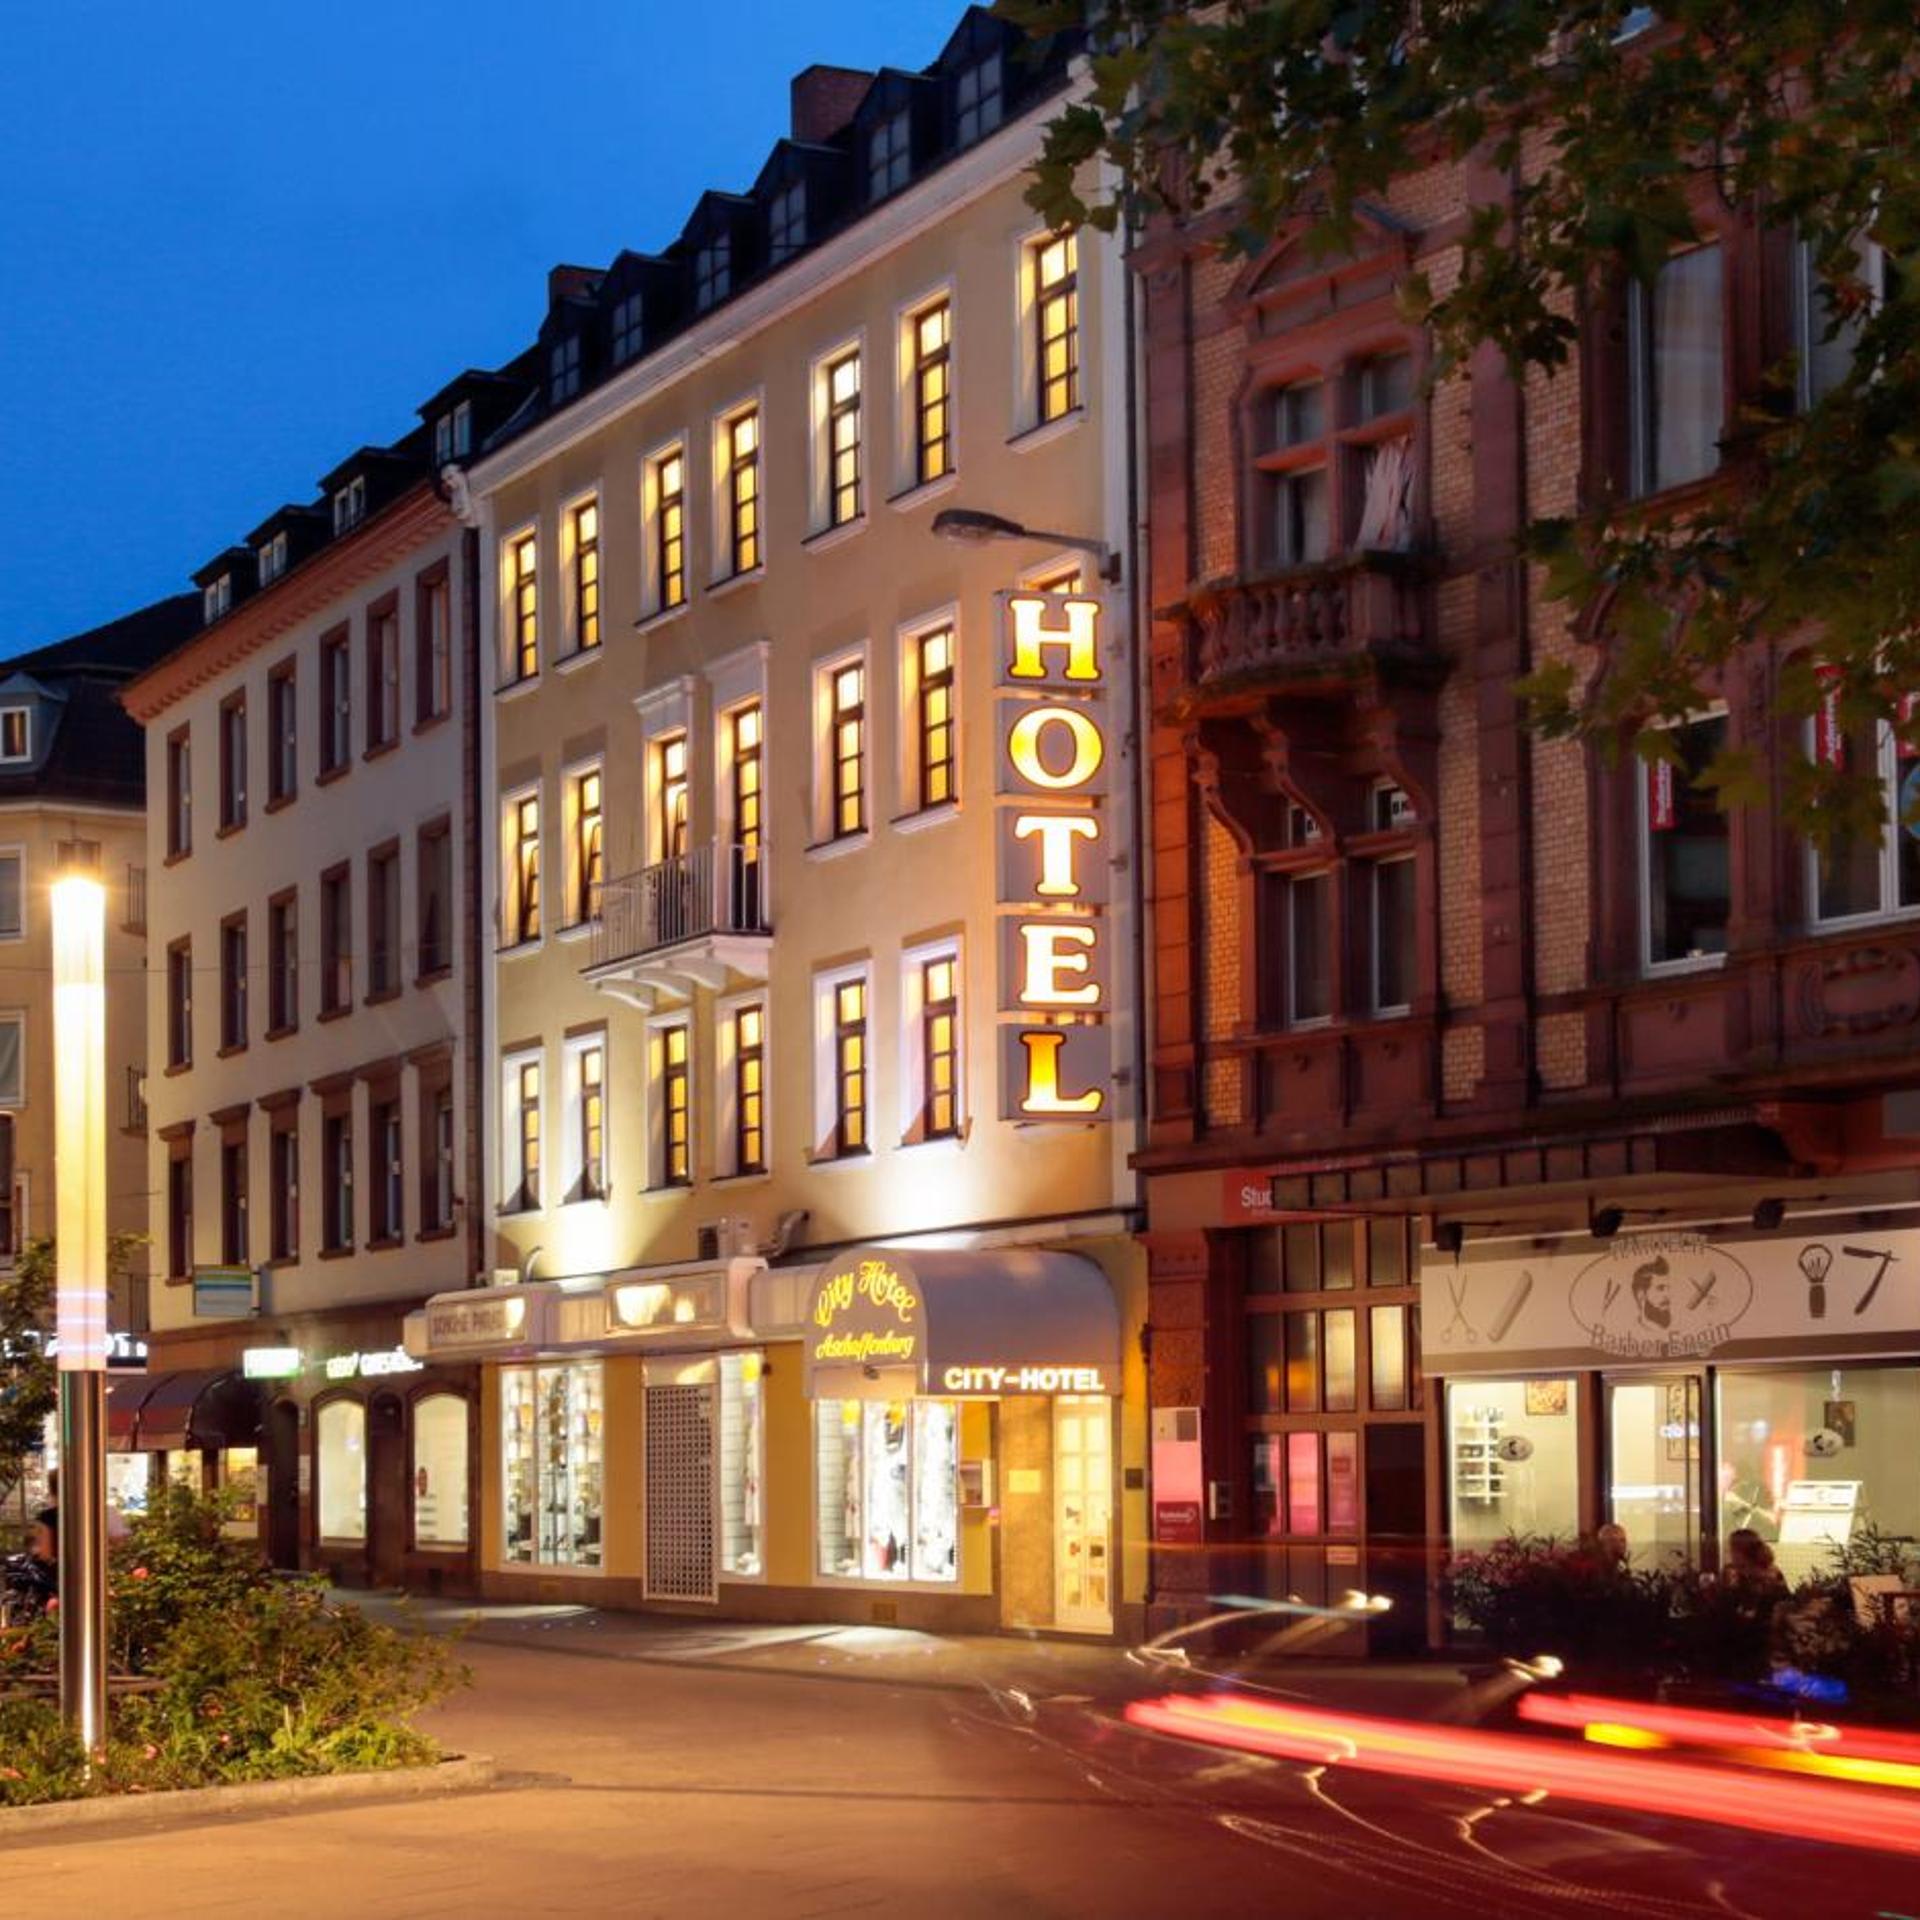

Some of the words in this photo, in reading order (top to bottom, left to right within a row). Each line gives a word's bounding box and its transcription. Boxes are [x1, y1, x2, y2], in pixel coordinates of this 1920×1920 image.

[1007, 597, 1104, 1114] HOTEL
[816, 1272, 855, 1327] City
[857, 1261, 916, 1323] Hotel
[1590, 1323, 1662, 1357] Barber
[944, 1367, 1106, 1391] CITY-HOTEL
